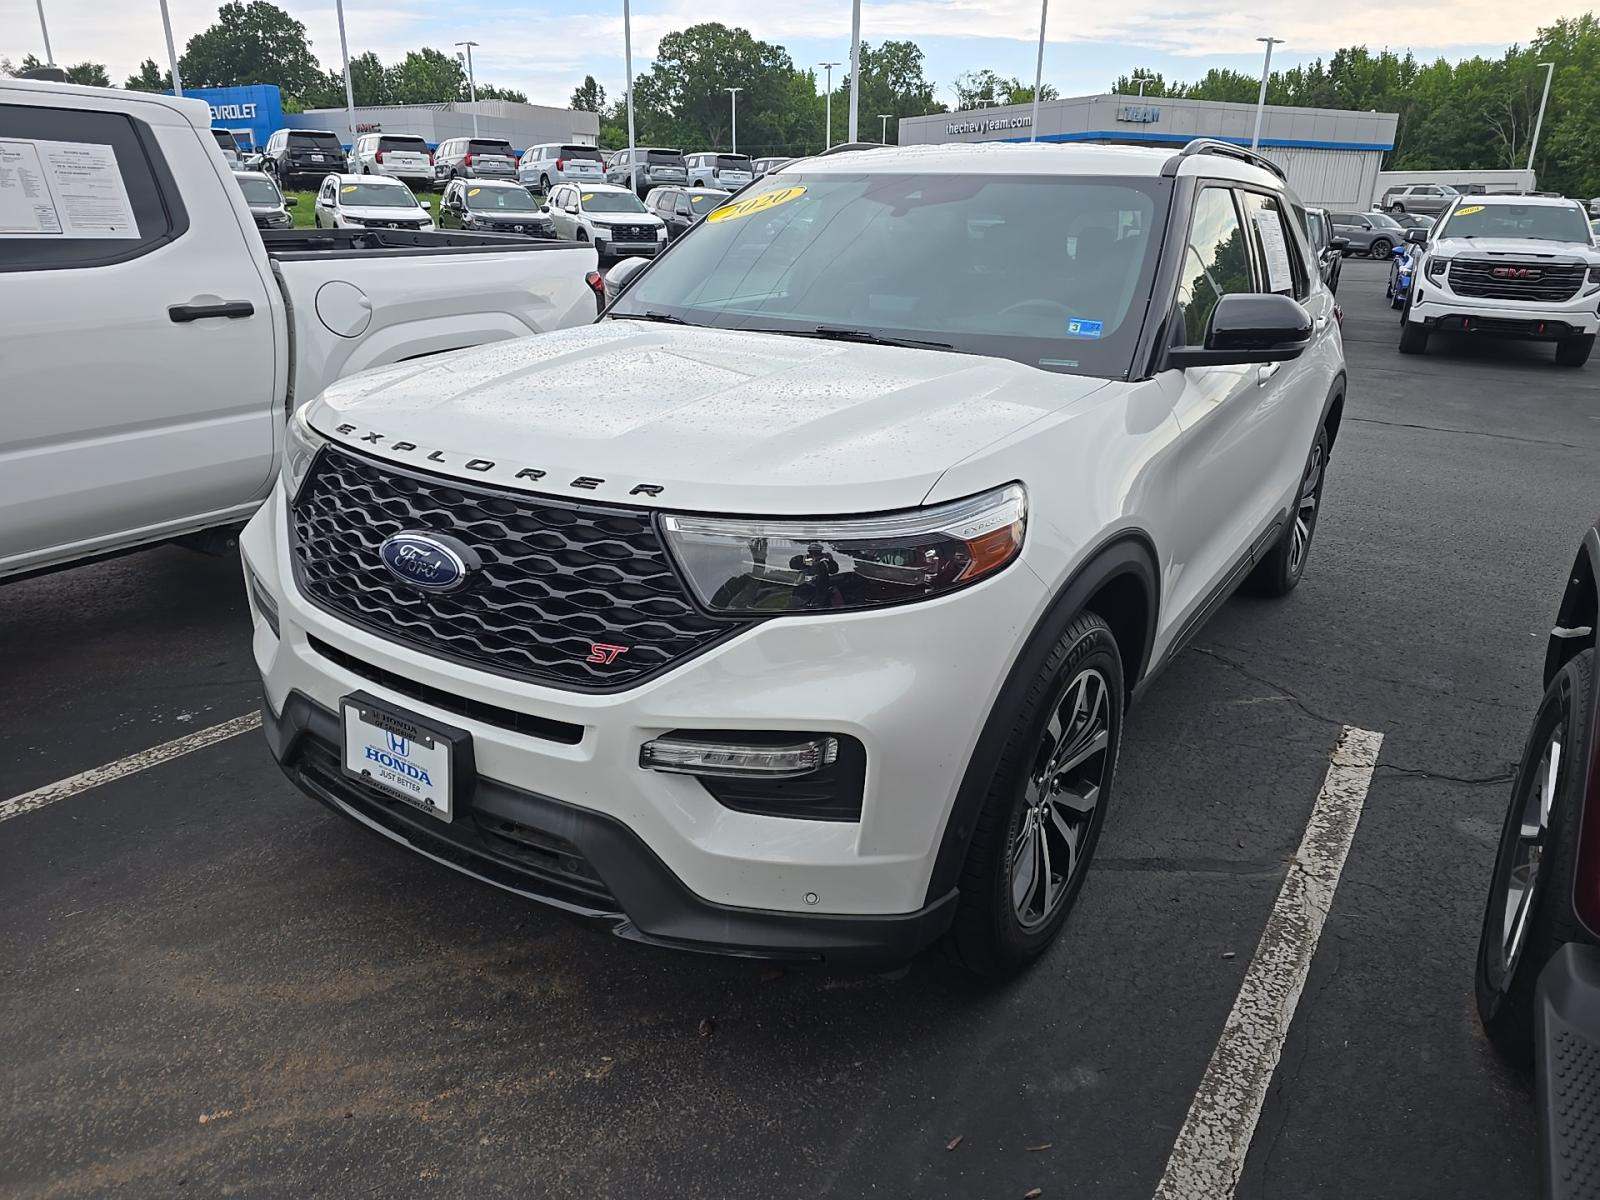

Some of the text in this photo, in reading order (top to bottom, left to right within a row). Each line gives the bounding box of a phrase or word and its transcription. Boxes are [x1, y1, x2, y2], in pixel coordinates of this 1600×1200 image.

[718, 188, 792, 222] 2020
[1493, 267, 1542, 279] GMC
[335, 423, 665, 498] EXPLORER
[393, 544, 443, 581] Ford
[586, 643, 630, 665] ST
[364, 746, 434, 788] HONDA
[379, 769, 396, 783] JUST
[396, 776, 421, 794] BETTER
